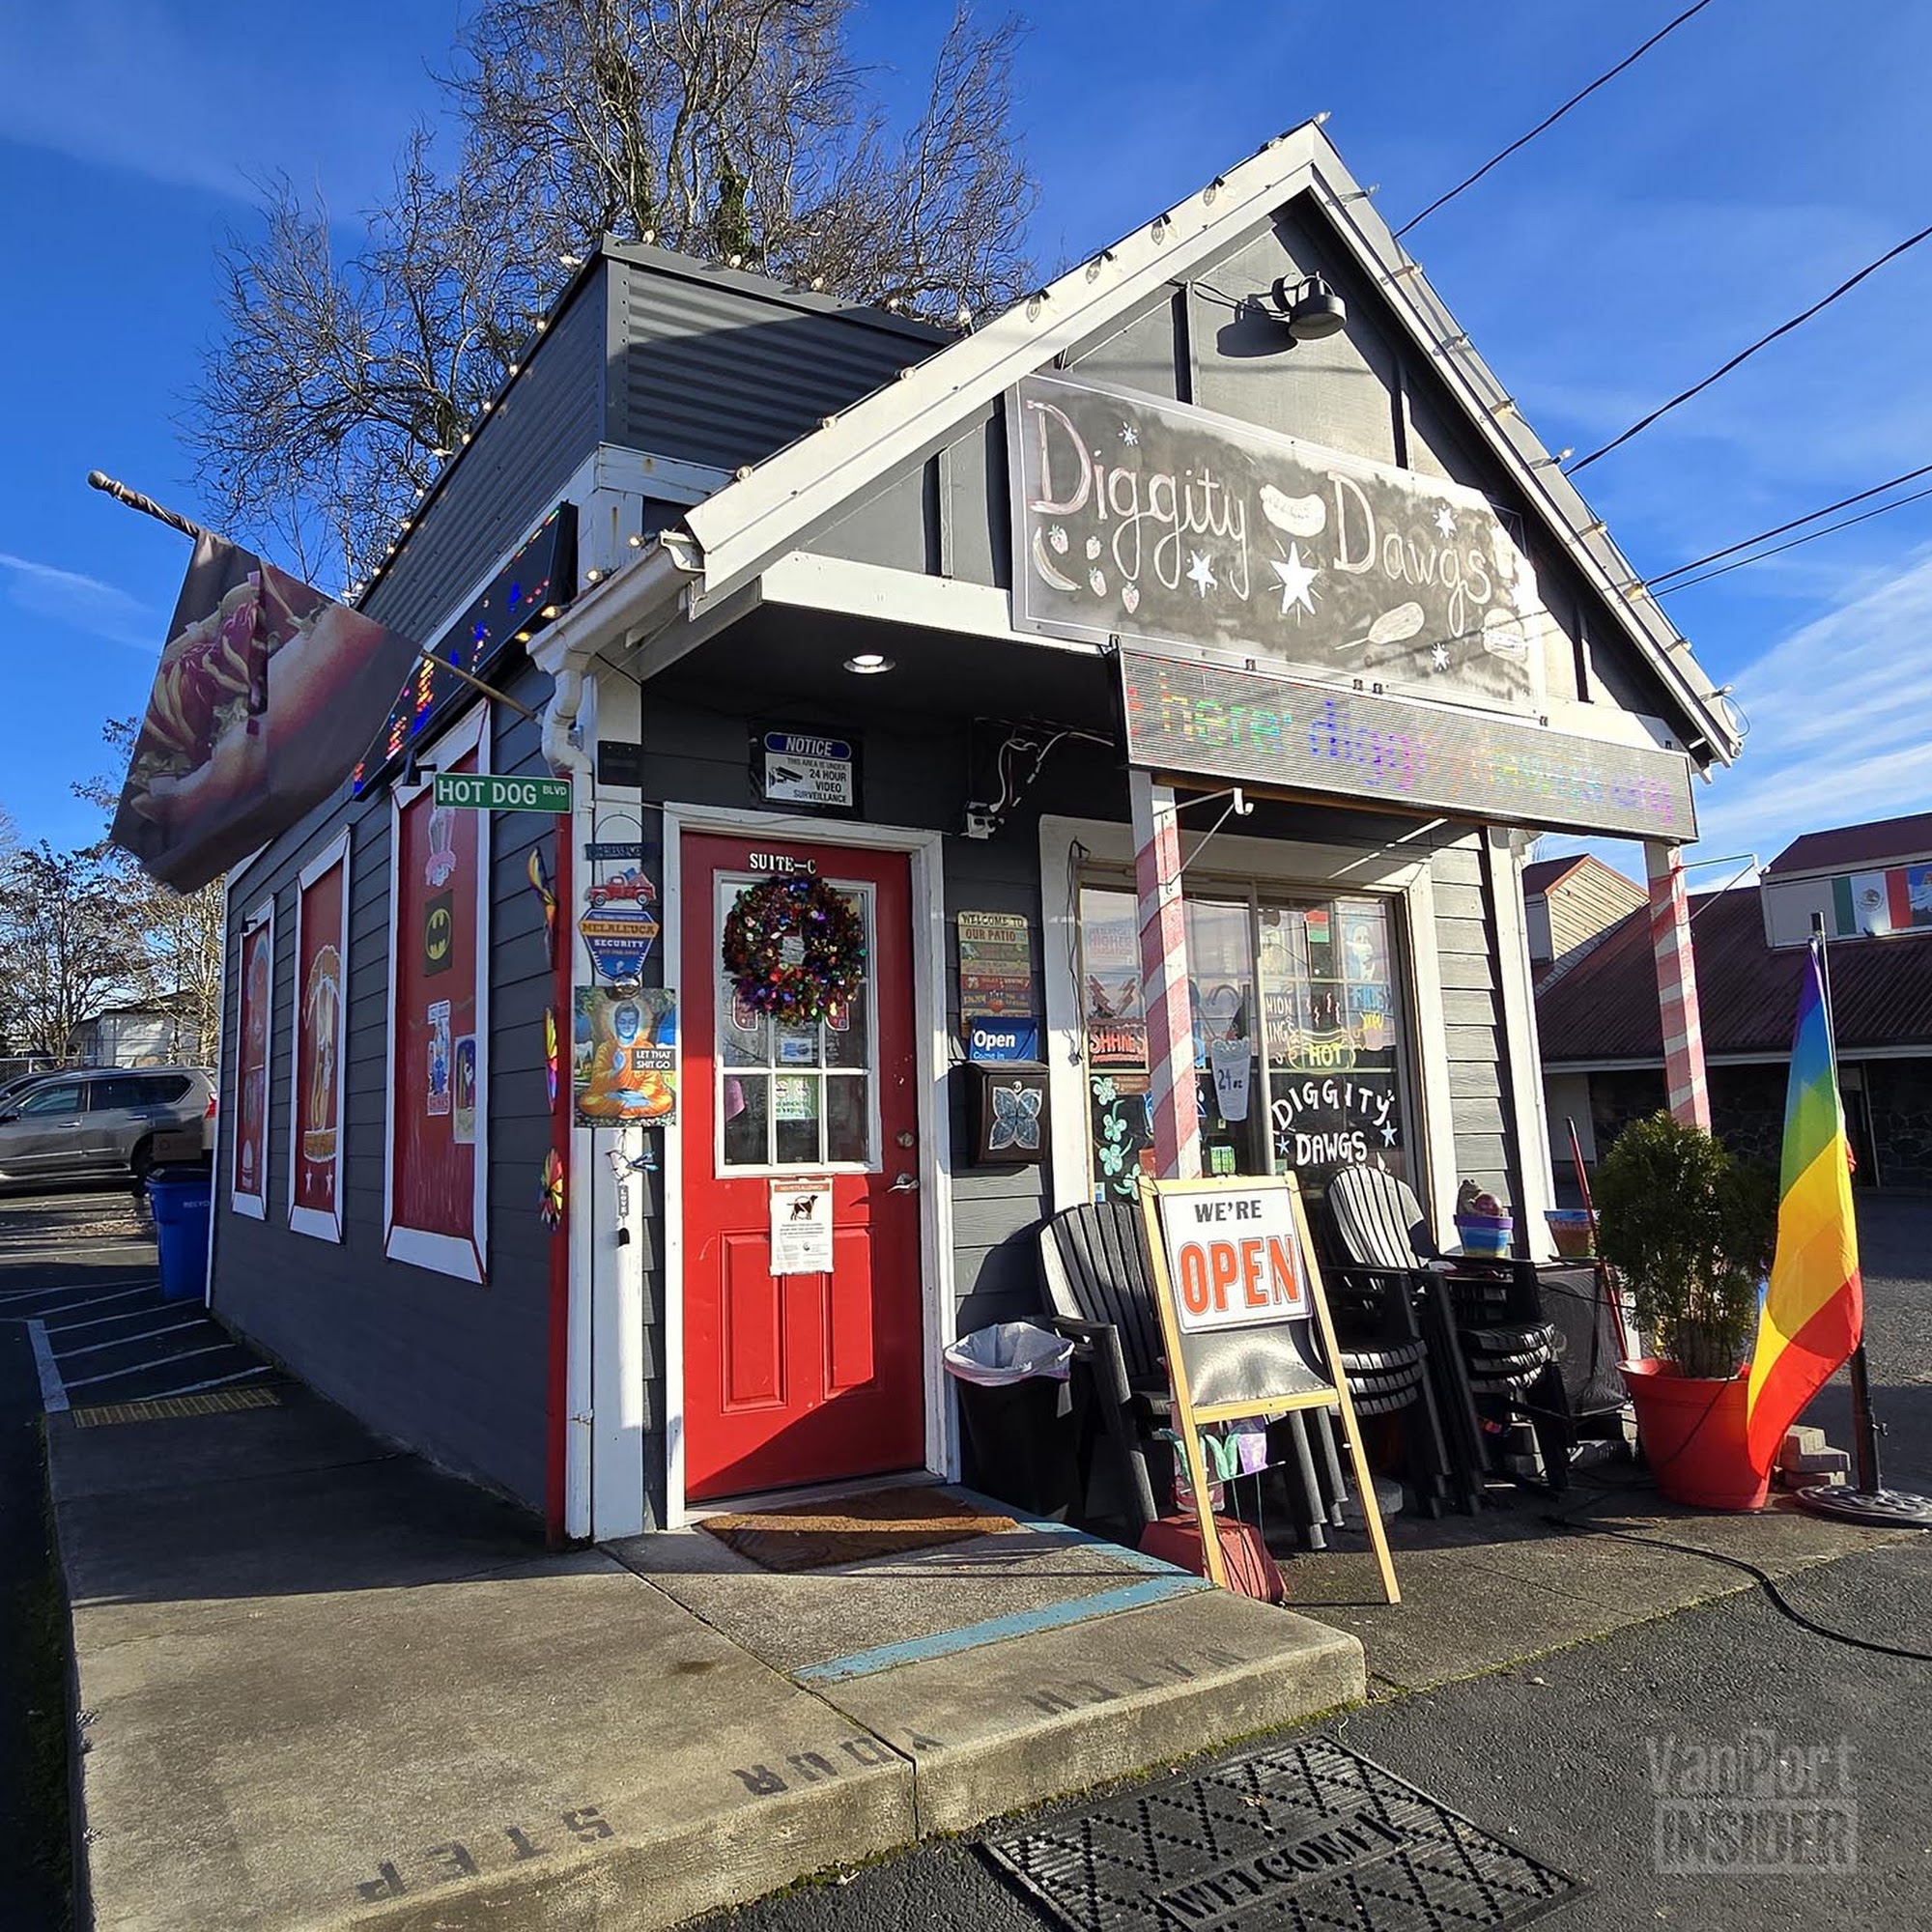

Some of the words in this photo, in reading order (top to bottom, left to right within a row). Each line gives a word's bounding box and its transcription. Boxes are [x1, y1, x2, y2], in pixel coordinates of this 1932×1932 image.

[1026, 399, 1251, 601] Diggity
[785, 737, 833, 755] NOTICE
[786, 757, 801, 766] THIS
[803, 758, 817, 768] AREA
[825, 761, 846, 771] UNDER
[809, 769, 820, 779] 24
[822, 770, 847, 782] HOUR
[438, 780, 485, 803] HOT
[493, 781, 537, 805] DOG
[542, 784, 568, 798] BLVD
[793, 789, 847, 803] SURVEILLANCE
[815, 781, 841, 792] VIDEO
[582, 923, 654, 935] MELALEUCA
[961, 914, 1009, 926] WELCOME
[1012, 918, 1023, 927] TO
[966, 928, 985, 940] OUR
[987, 929, 1015, 942] PATIO
[973, 1030, 1015, 1051] Open
[1308, 1042, 1343, 1066] HOT
[637, 1061, 654, 1069] SHIT
[658, 1061, 669, 1069] GO
[1295, 1130, 1368, 1166] DAWGS
[1195, 1200, 1262, 1223] WE'RE
[1179, 1235, 1300, 1316] OPEN
[732, 1726, 945, 1796] YOUR
[356, 1807, 614, 1902] STEP
